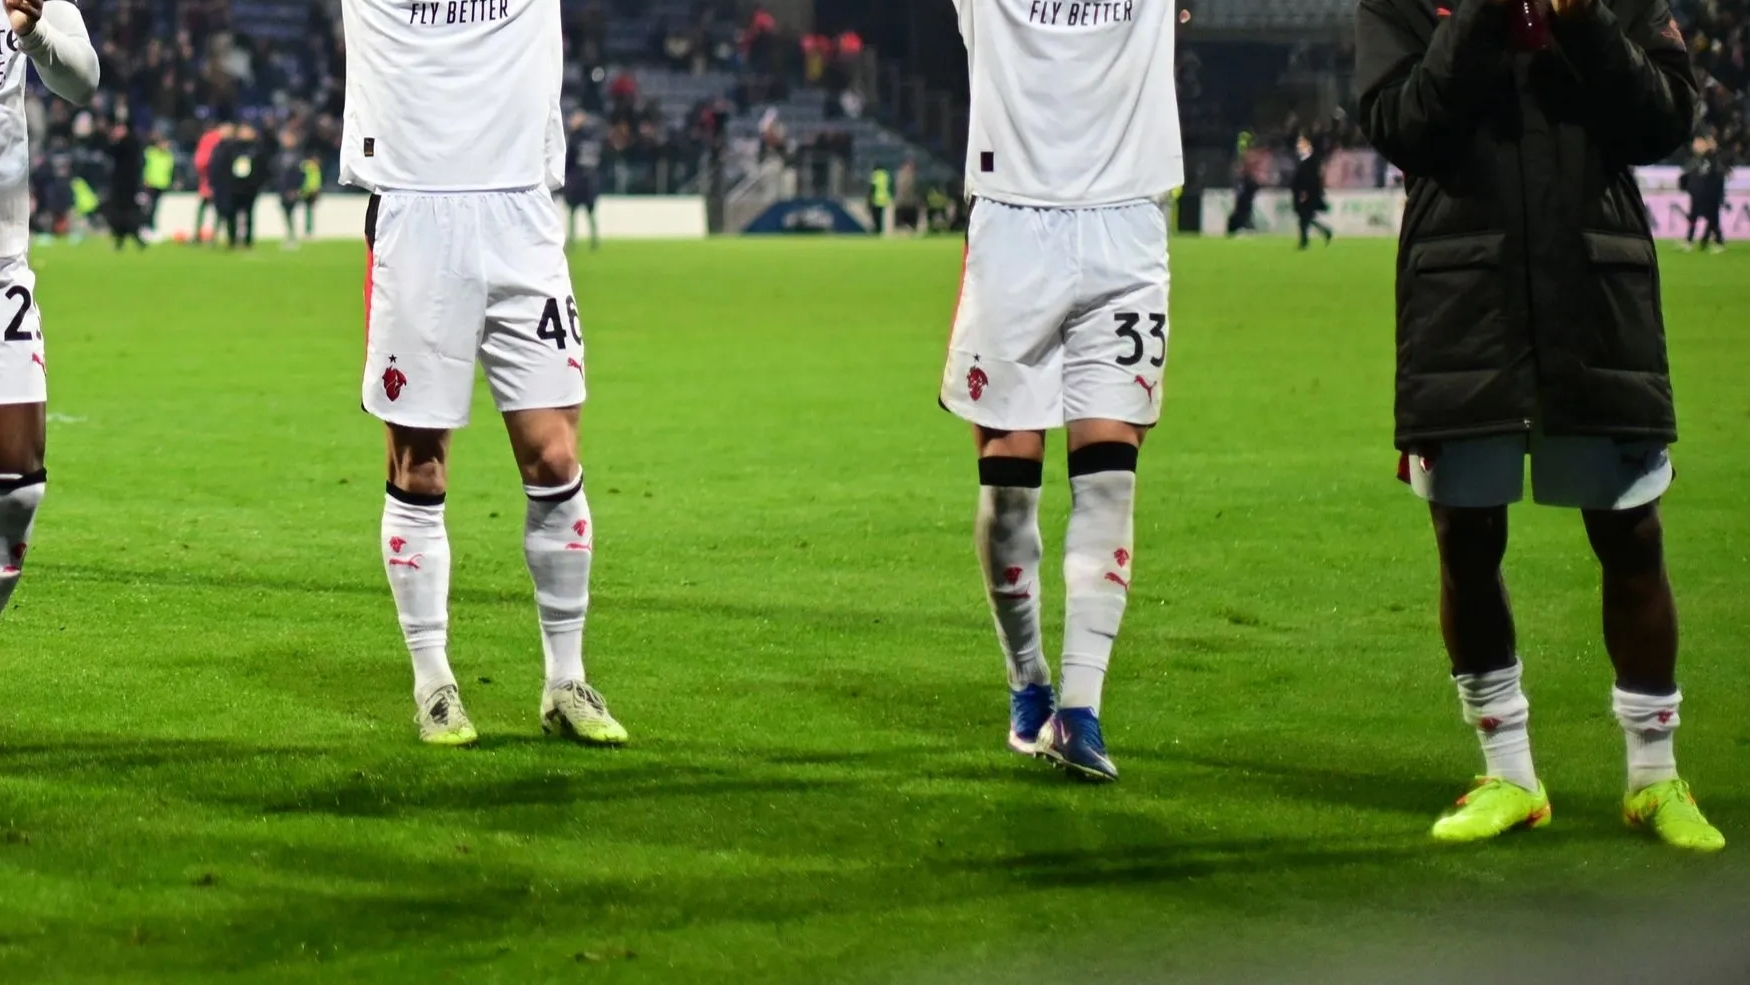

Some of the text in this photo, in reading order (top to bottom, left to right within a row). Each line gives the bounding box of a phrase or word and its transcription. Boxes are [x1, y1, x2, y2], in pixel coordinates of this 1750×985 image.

[410, 2, 439, 25] FLY
[1030, 0, 1133, 26] FLY BETTER
[4, 285, 42, 341] 2
[1114, 312, 1166, 367] 33
